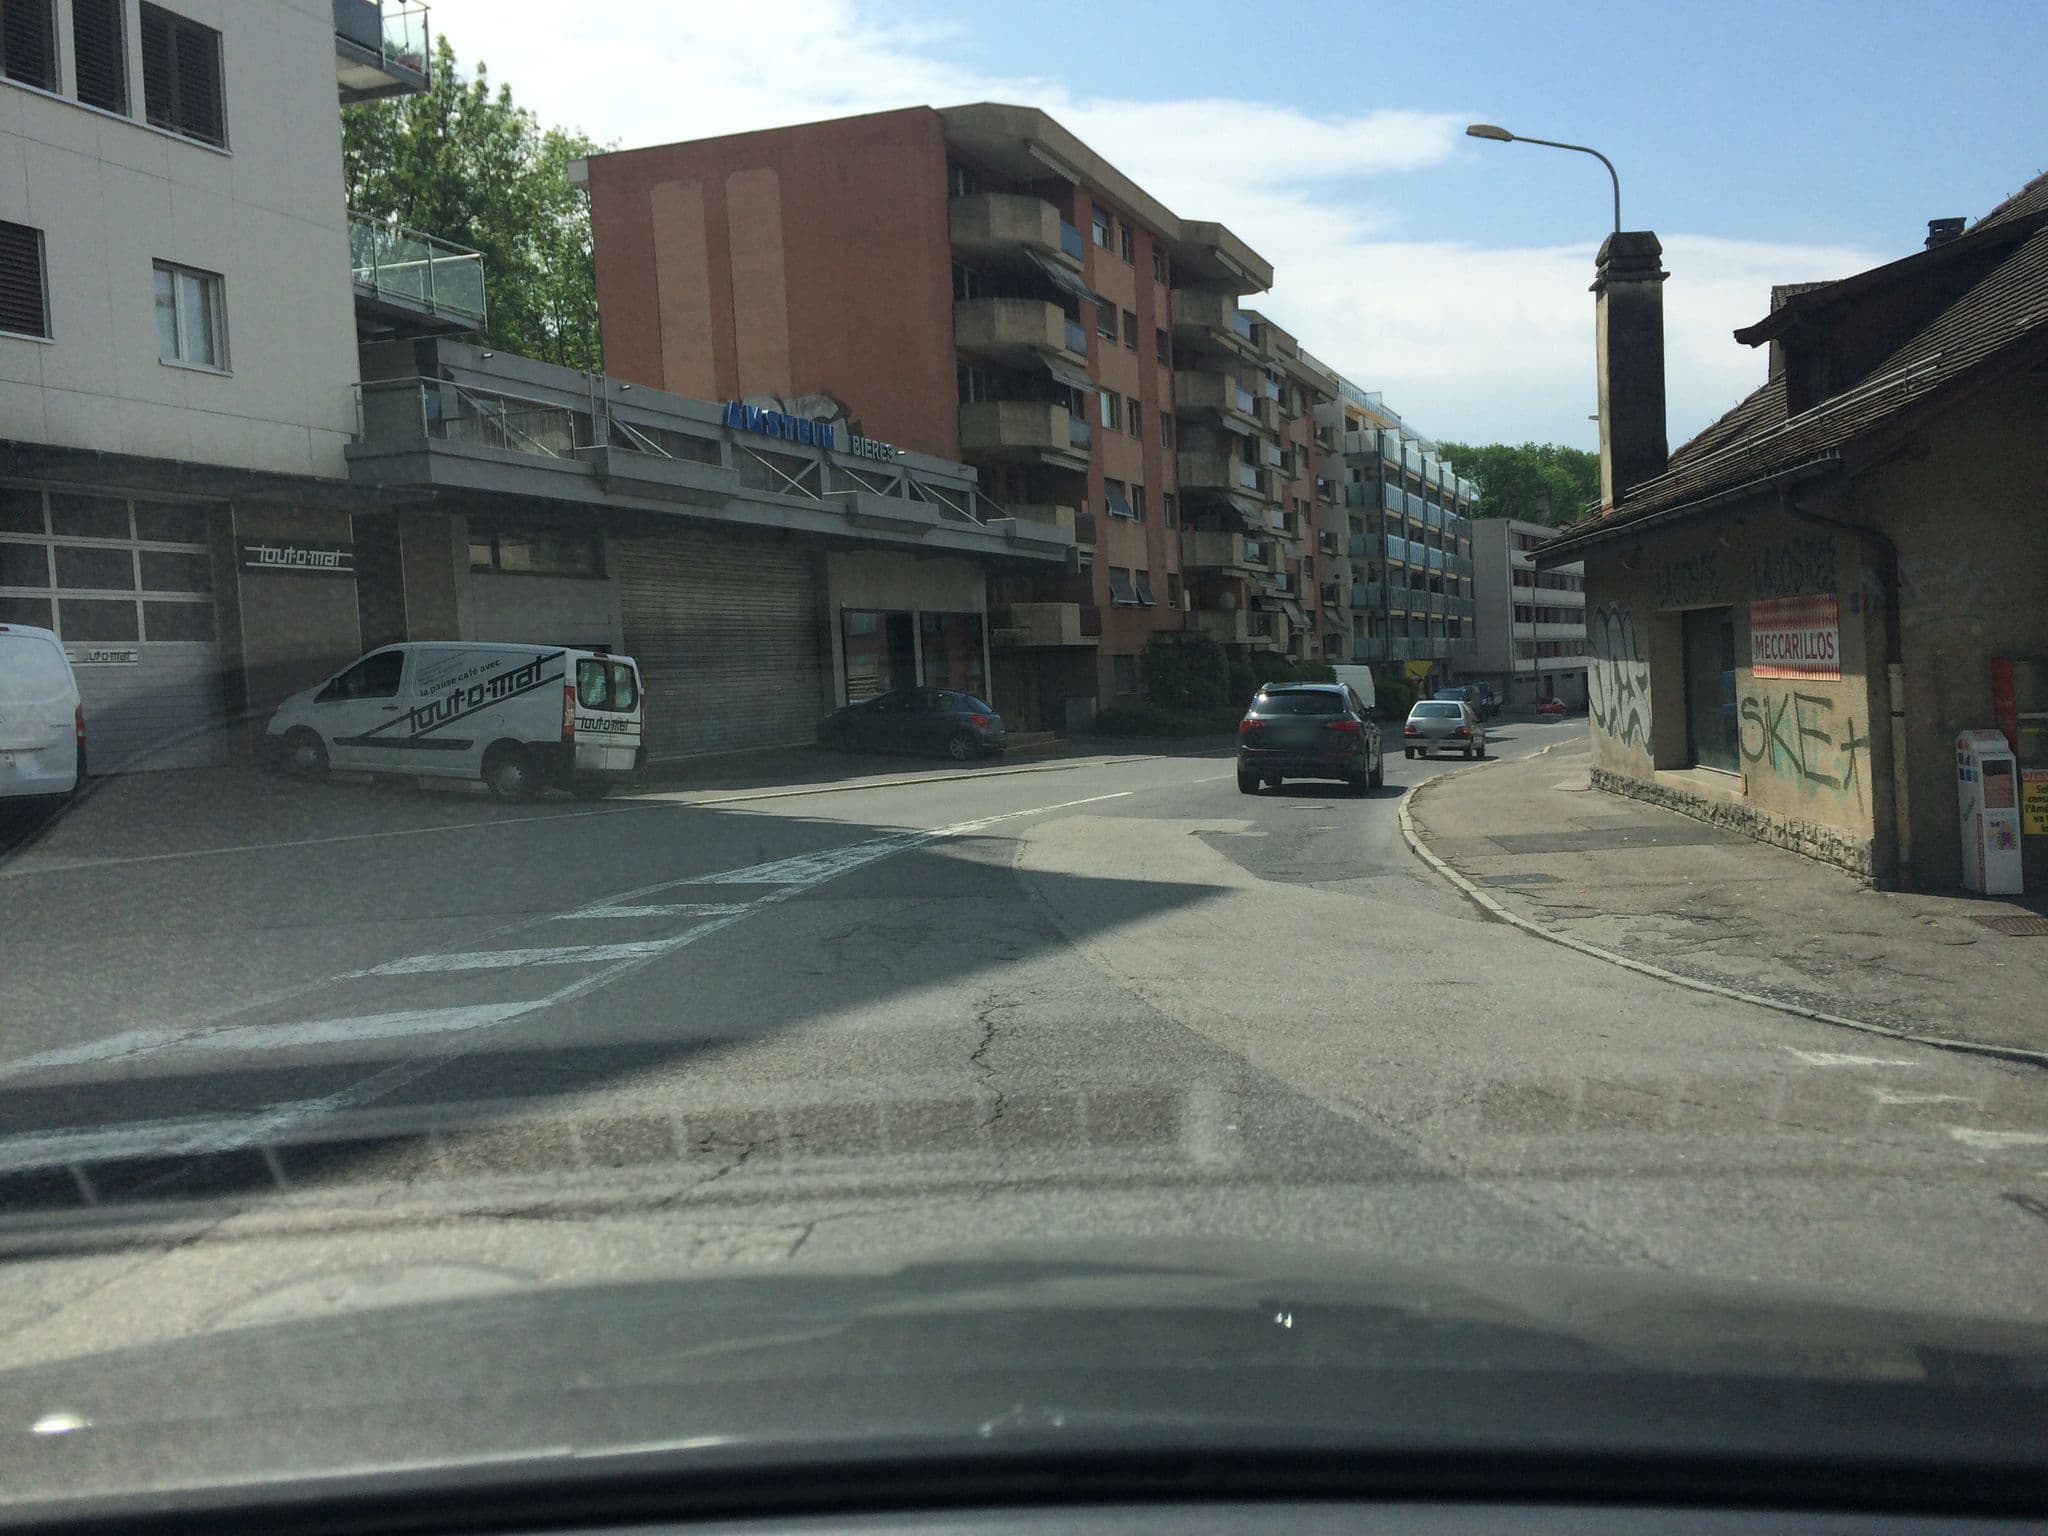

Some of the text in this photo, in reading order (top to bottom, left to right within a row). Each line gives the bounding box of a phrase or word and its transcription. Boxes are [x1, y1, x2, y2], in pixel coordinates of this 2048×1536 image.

[722, 400, 897, 463] AMSTEIN BIERES
[1755, 631, 1835, 660] MECCARILLOS
[430, 679, 458, 696] pause
[480, 660, 502, 673] avec
